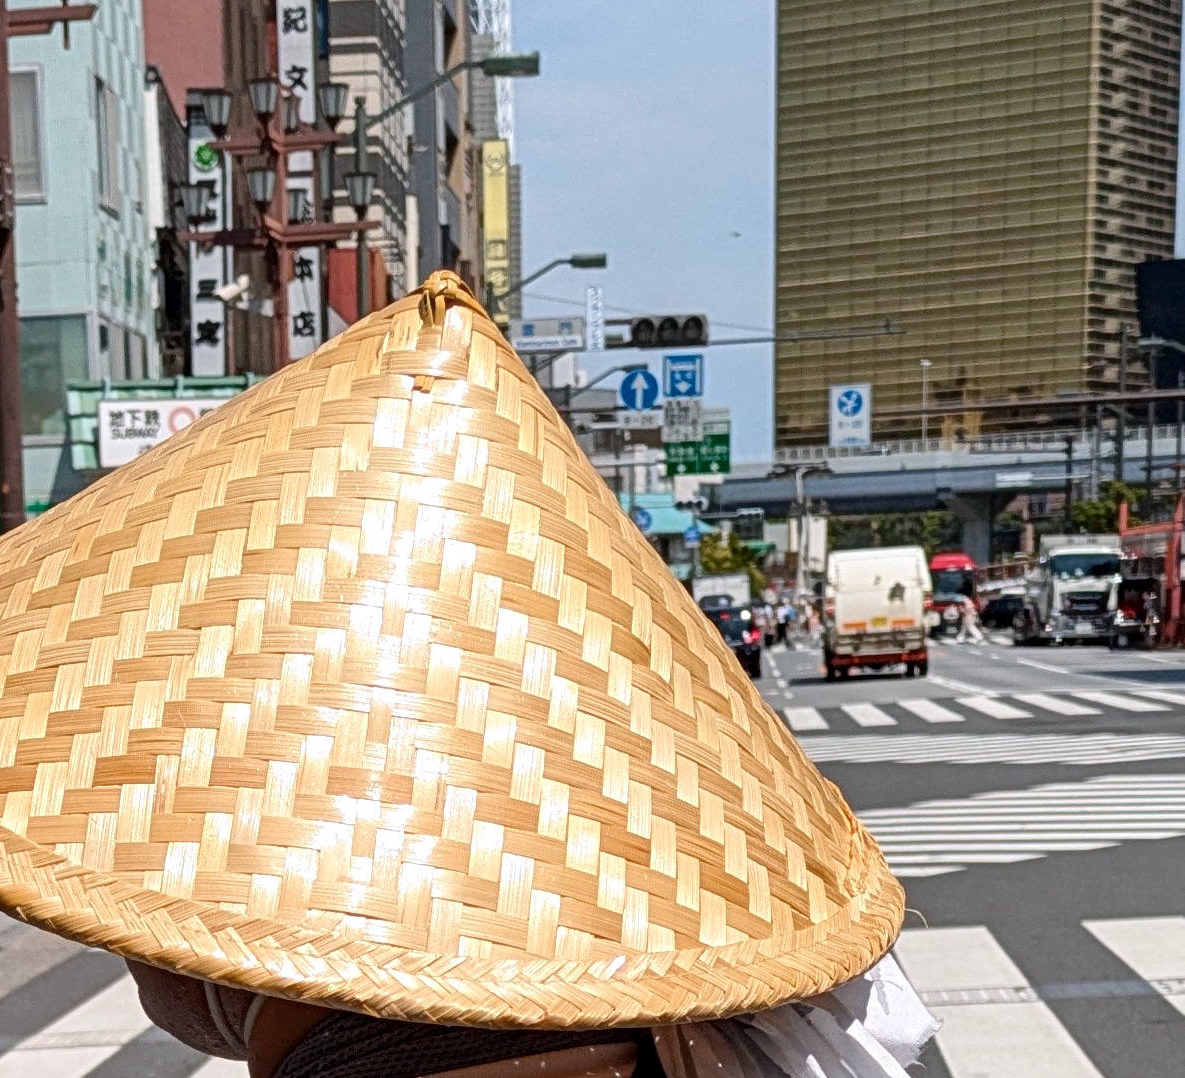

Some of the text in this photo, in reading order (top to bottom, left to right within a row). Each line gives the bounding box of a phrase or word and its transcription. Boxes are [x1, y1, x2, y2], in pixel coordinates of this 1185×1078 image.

[109, 409, 160, 428] 地下鉄
[110, 428, 160, 440] SUBWAY
